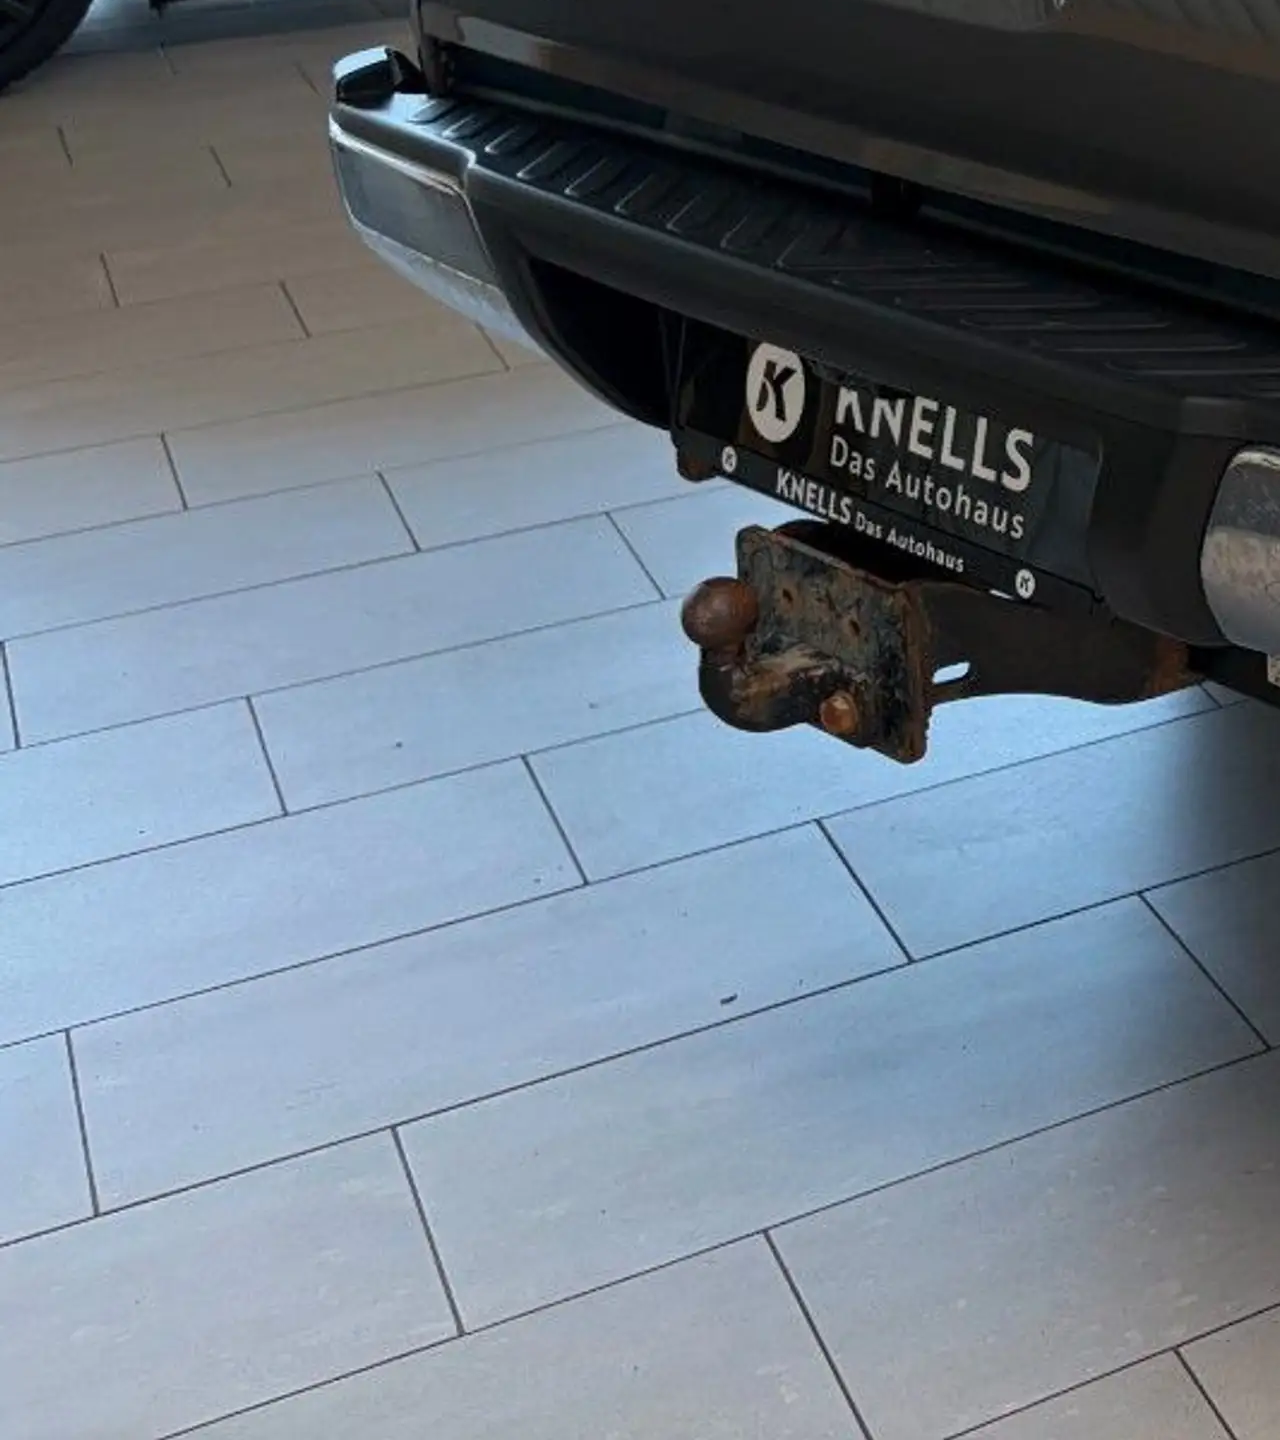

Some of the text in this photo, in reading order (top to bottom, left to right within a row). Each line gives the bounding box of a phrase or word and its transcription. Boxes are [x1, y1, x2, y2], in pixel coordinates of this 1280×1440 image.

[776, 468, 965, 574] KNELLS Das Autohaus
[830, 435, 1024, 540] Das Autohaus
